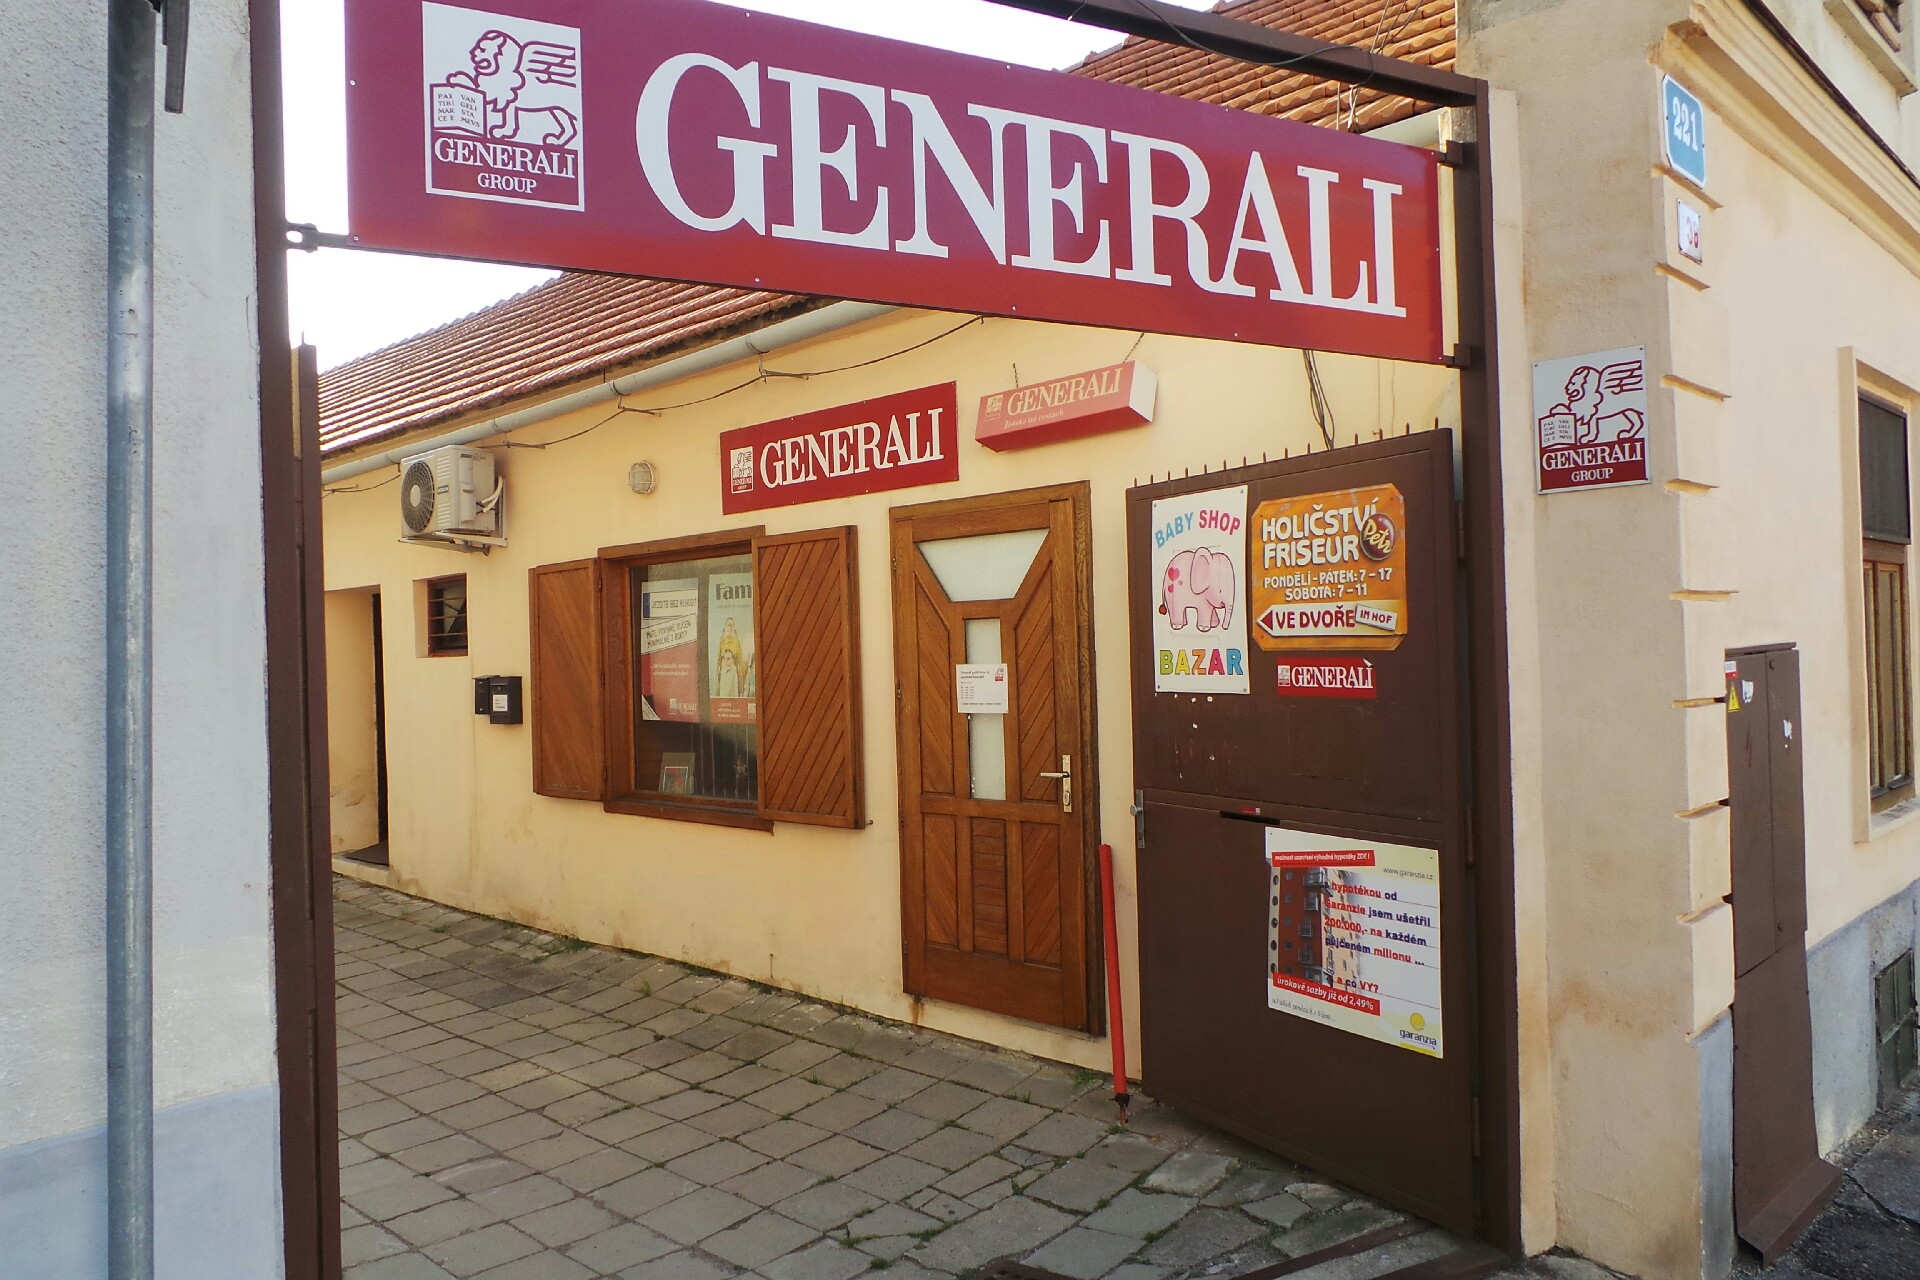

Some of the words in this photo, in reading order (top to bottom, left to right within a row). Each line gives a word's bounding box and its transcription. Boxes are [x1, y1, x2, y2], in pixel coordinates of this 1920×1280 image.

[461, 94, 476, 104] VAN
[1672, 96, 1698, 151] 221
[434, 137, 576, 179] GENERALI
[477, 172, 537, 194] GROUP
[635, 52, 1407, 318] GENERALI
[1007, 367, 1123, 416] GENERALI
[760, 408, 944, 489] GENERALI
[1542, 442, 1643, 470] GENERALI
[1571, 467, 1613, 482] GROUP
[1154, 511, 1194, 548] BABY
[1199, 509, 1241, 535] SHOP
[1262, 496, 1379, 542] HOLIČSTVÍ
[1364, 518, 1391, 554] Petr
[1264, 534, 1359, 569] FRISEUR
[1285, 586, 1336, 602] SOBOTA:
[1356, 583, 1368, 596] 11
[1275, 610, 1296, 629] VE
[1300, 604, 1356, 629] DVOŘE
[1372, 611, 1393, 624] HOF
[1159, 649, 1243, 675] BAZAR
[1291, 666, 1373, 688] GENERALI
[1383, 867, 1434, 880] www.garanzia.cz
[1331, 881, 1381, 899] hypotékou
[1384, 891, 1397, 901] od
[1324, 896, 1366, 914] Garanzie
[1368, 906, 1393, 919] jsem
[1396, 912, 1431, 927] ušetřil
[1370, 928, 1383, 937] na
[1385, 929, 1427, 946] každém
[1373, 947, 1411, 963] milionu
[1277, 976, 1306, 991] úrokové
[1306, 984, 1327, 999] sazby
[1328, 988, 1337, 1001] již
[1338, 991, 1348, 1002] od
[1349, 997, 1374, 1011] 2,49%
[1360, 980, 1379, 993] VY?
[1400, 1029, 1437, 1045] garanzia
